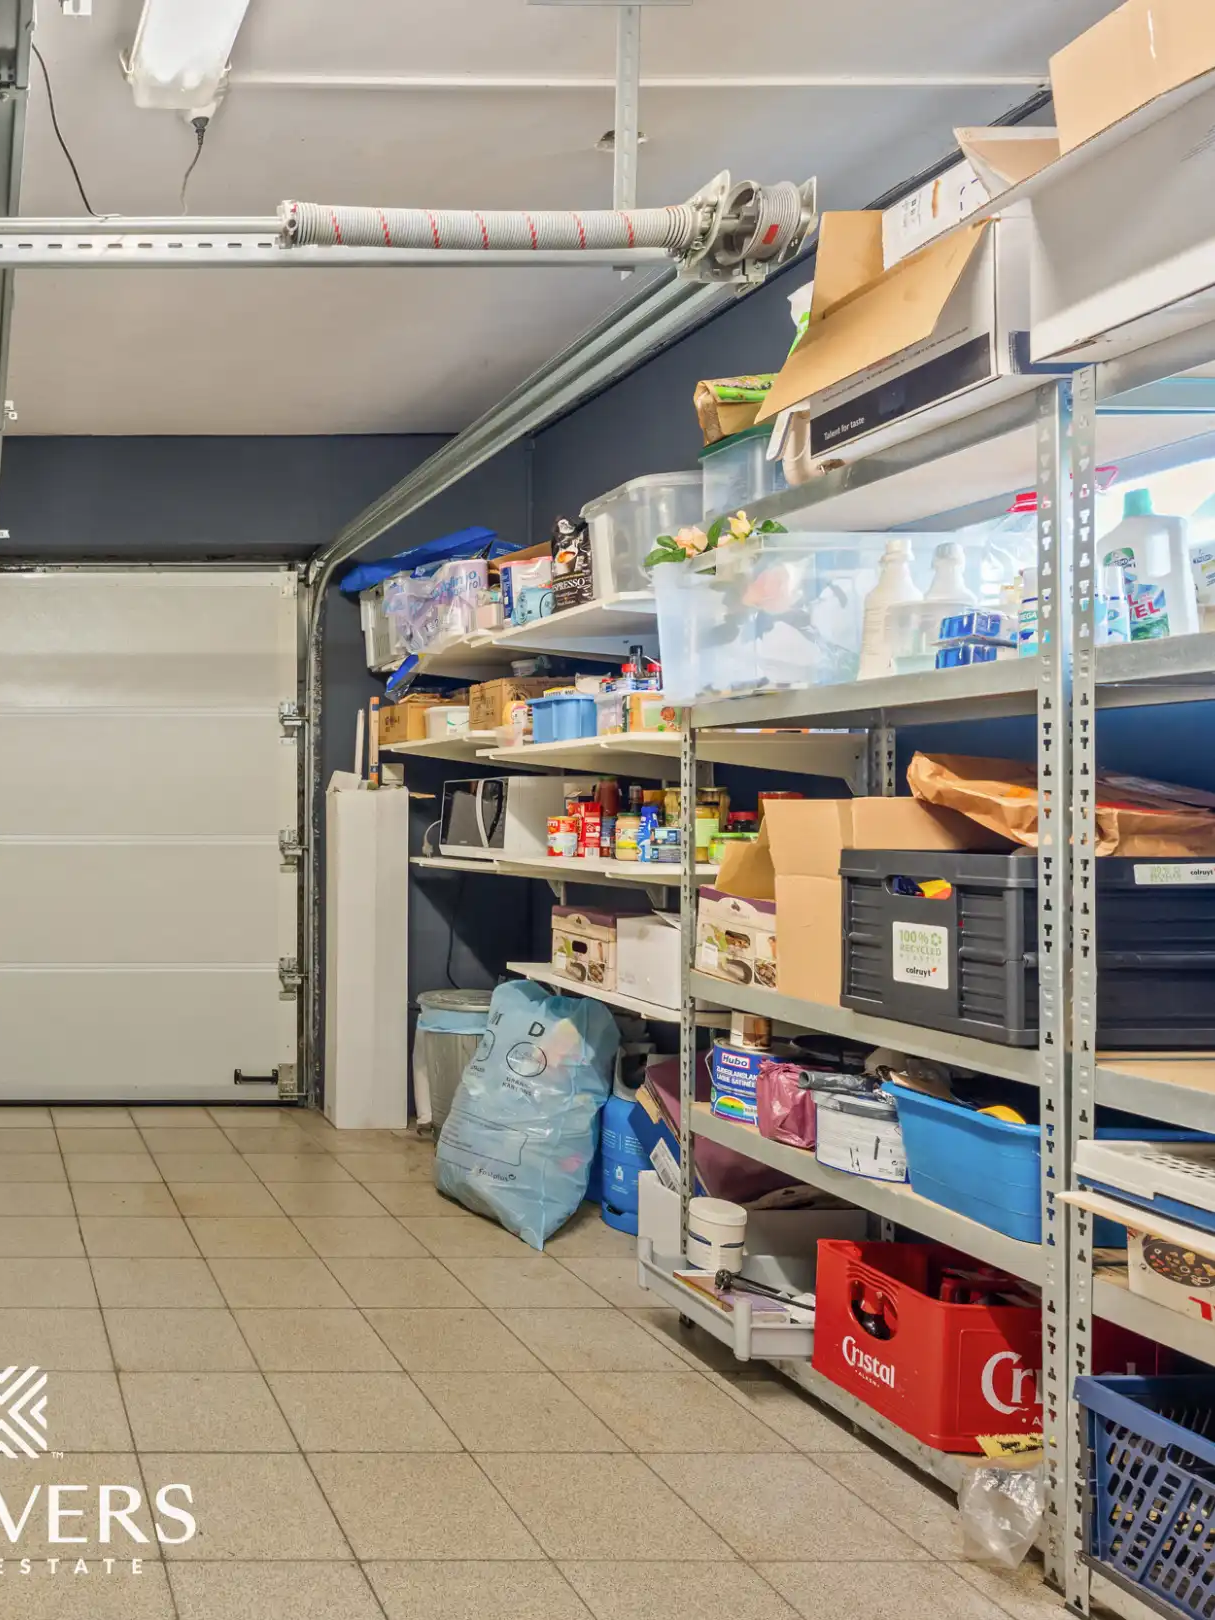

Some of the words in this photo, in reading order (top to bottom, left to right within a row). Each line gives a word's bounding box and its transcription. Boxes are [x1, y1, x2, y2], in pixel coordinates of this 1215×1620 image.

[823, 428, 841, 441] Talent
[849, 416, 866, 429] taste
[905, 966, 932, 978] colruyt
[528, 1021, 546, 1037] D
[723, 1054, 748, 1067] Hubo
[841, 1335, 895, 1389] Cristal
